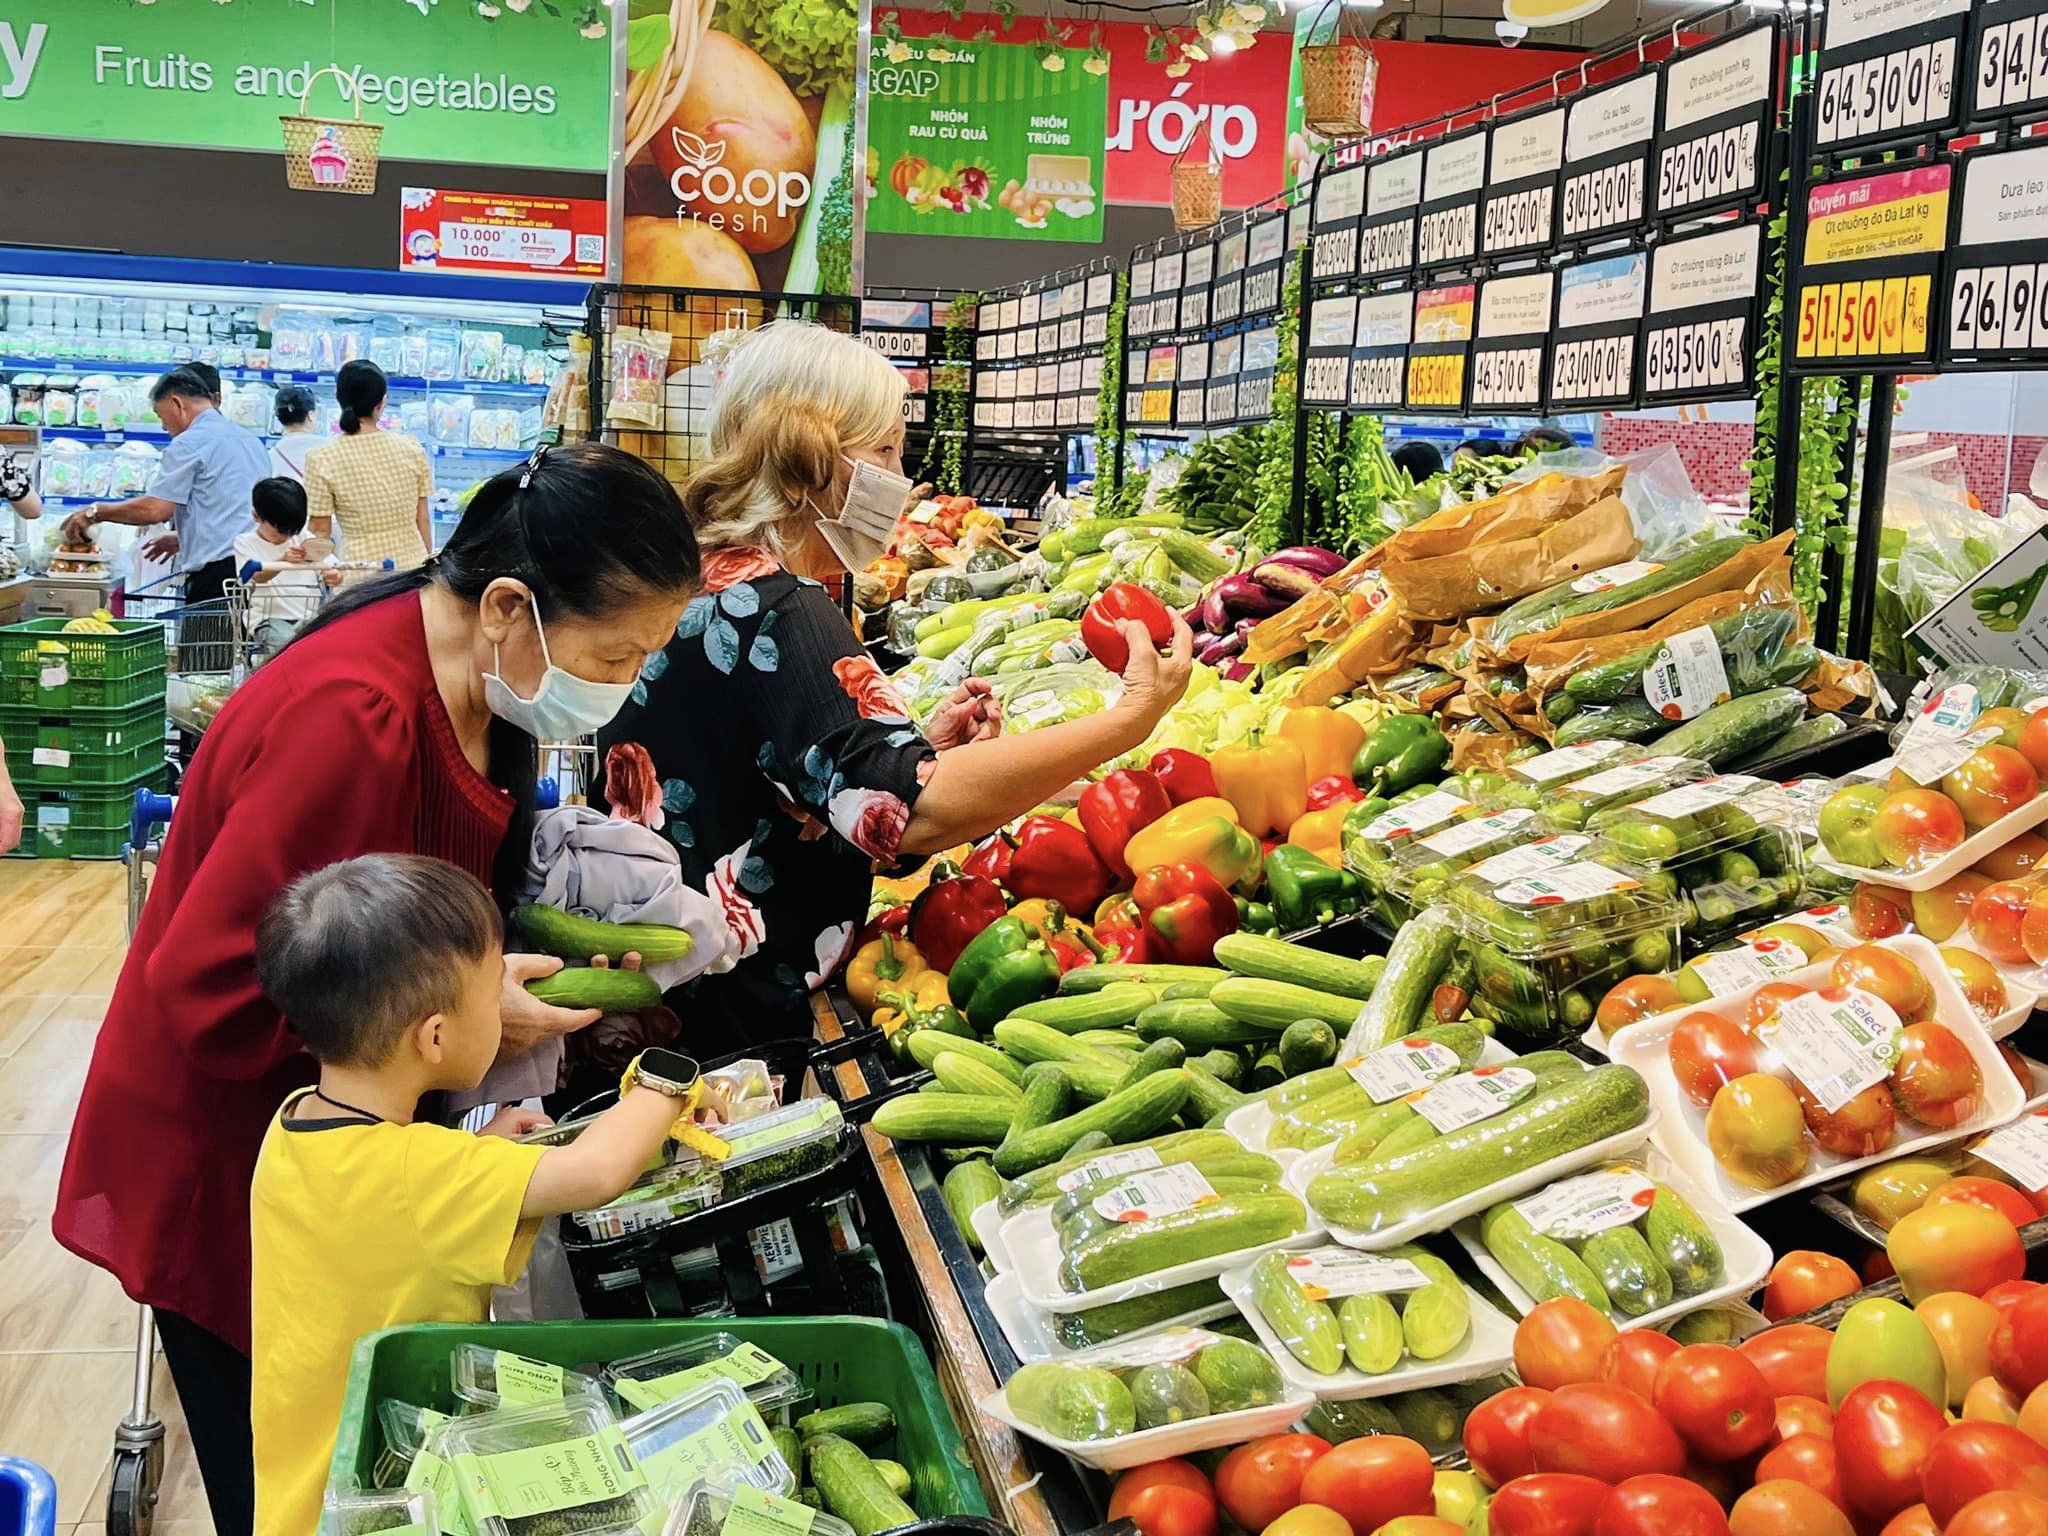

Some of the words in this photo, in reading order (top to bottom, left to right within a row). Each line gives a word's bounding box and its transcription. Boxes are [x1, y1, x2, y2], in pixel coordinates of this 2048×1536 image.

[95, 45, 213, 92] Fruits
[235, 64, 310, 98] and
[331, 64, 557, 116] Vegetables
[1822, 57, 1924, 125] 64.500
[931, 108, 969, 123] NHÓM
[1031, 115, 1068, 129] NHÓM
[909, 125, 935, 138] RAU
[1662, 138, 1736, 197] 52.000
[670, 165, 811, 218] co.op
[1565, 171, 1627, 222] 30.500
[1848, 184, 1871, 205] mãi
[2026, 179, 2044, 195] leo
[676, 204, 768, 233] fresh
[1917, 202, 1929, 218] kg
[463, 245, 489, 257] 100
[521, 232, 537, 244] 01
[1802, 290, 1897, 343] 51.500
[1557, 346, 1615, 388] 23.000
[1649, 328, 1721, 379] 63.500
[1477, 358, 1525, 392] 46.500
[1655, 667, 1670, 702] Select
[1847, 999, 1886, 1036] Select
[758, 1227, 777, 1263] KEWPIE
[527, 1371, 558, 1384] RONG
[717, 1422, 735, 1442] NHO
[586, 1440, 602, 1463] NHO
[597, 1464, 618, 1494] RONG
